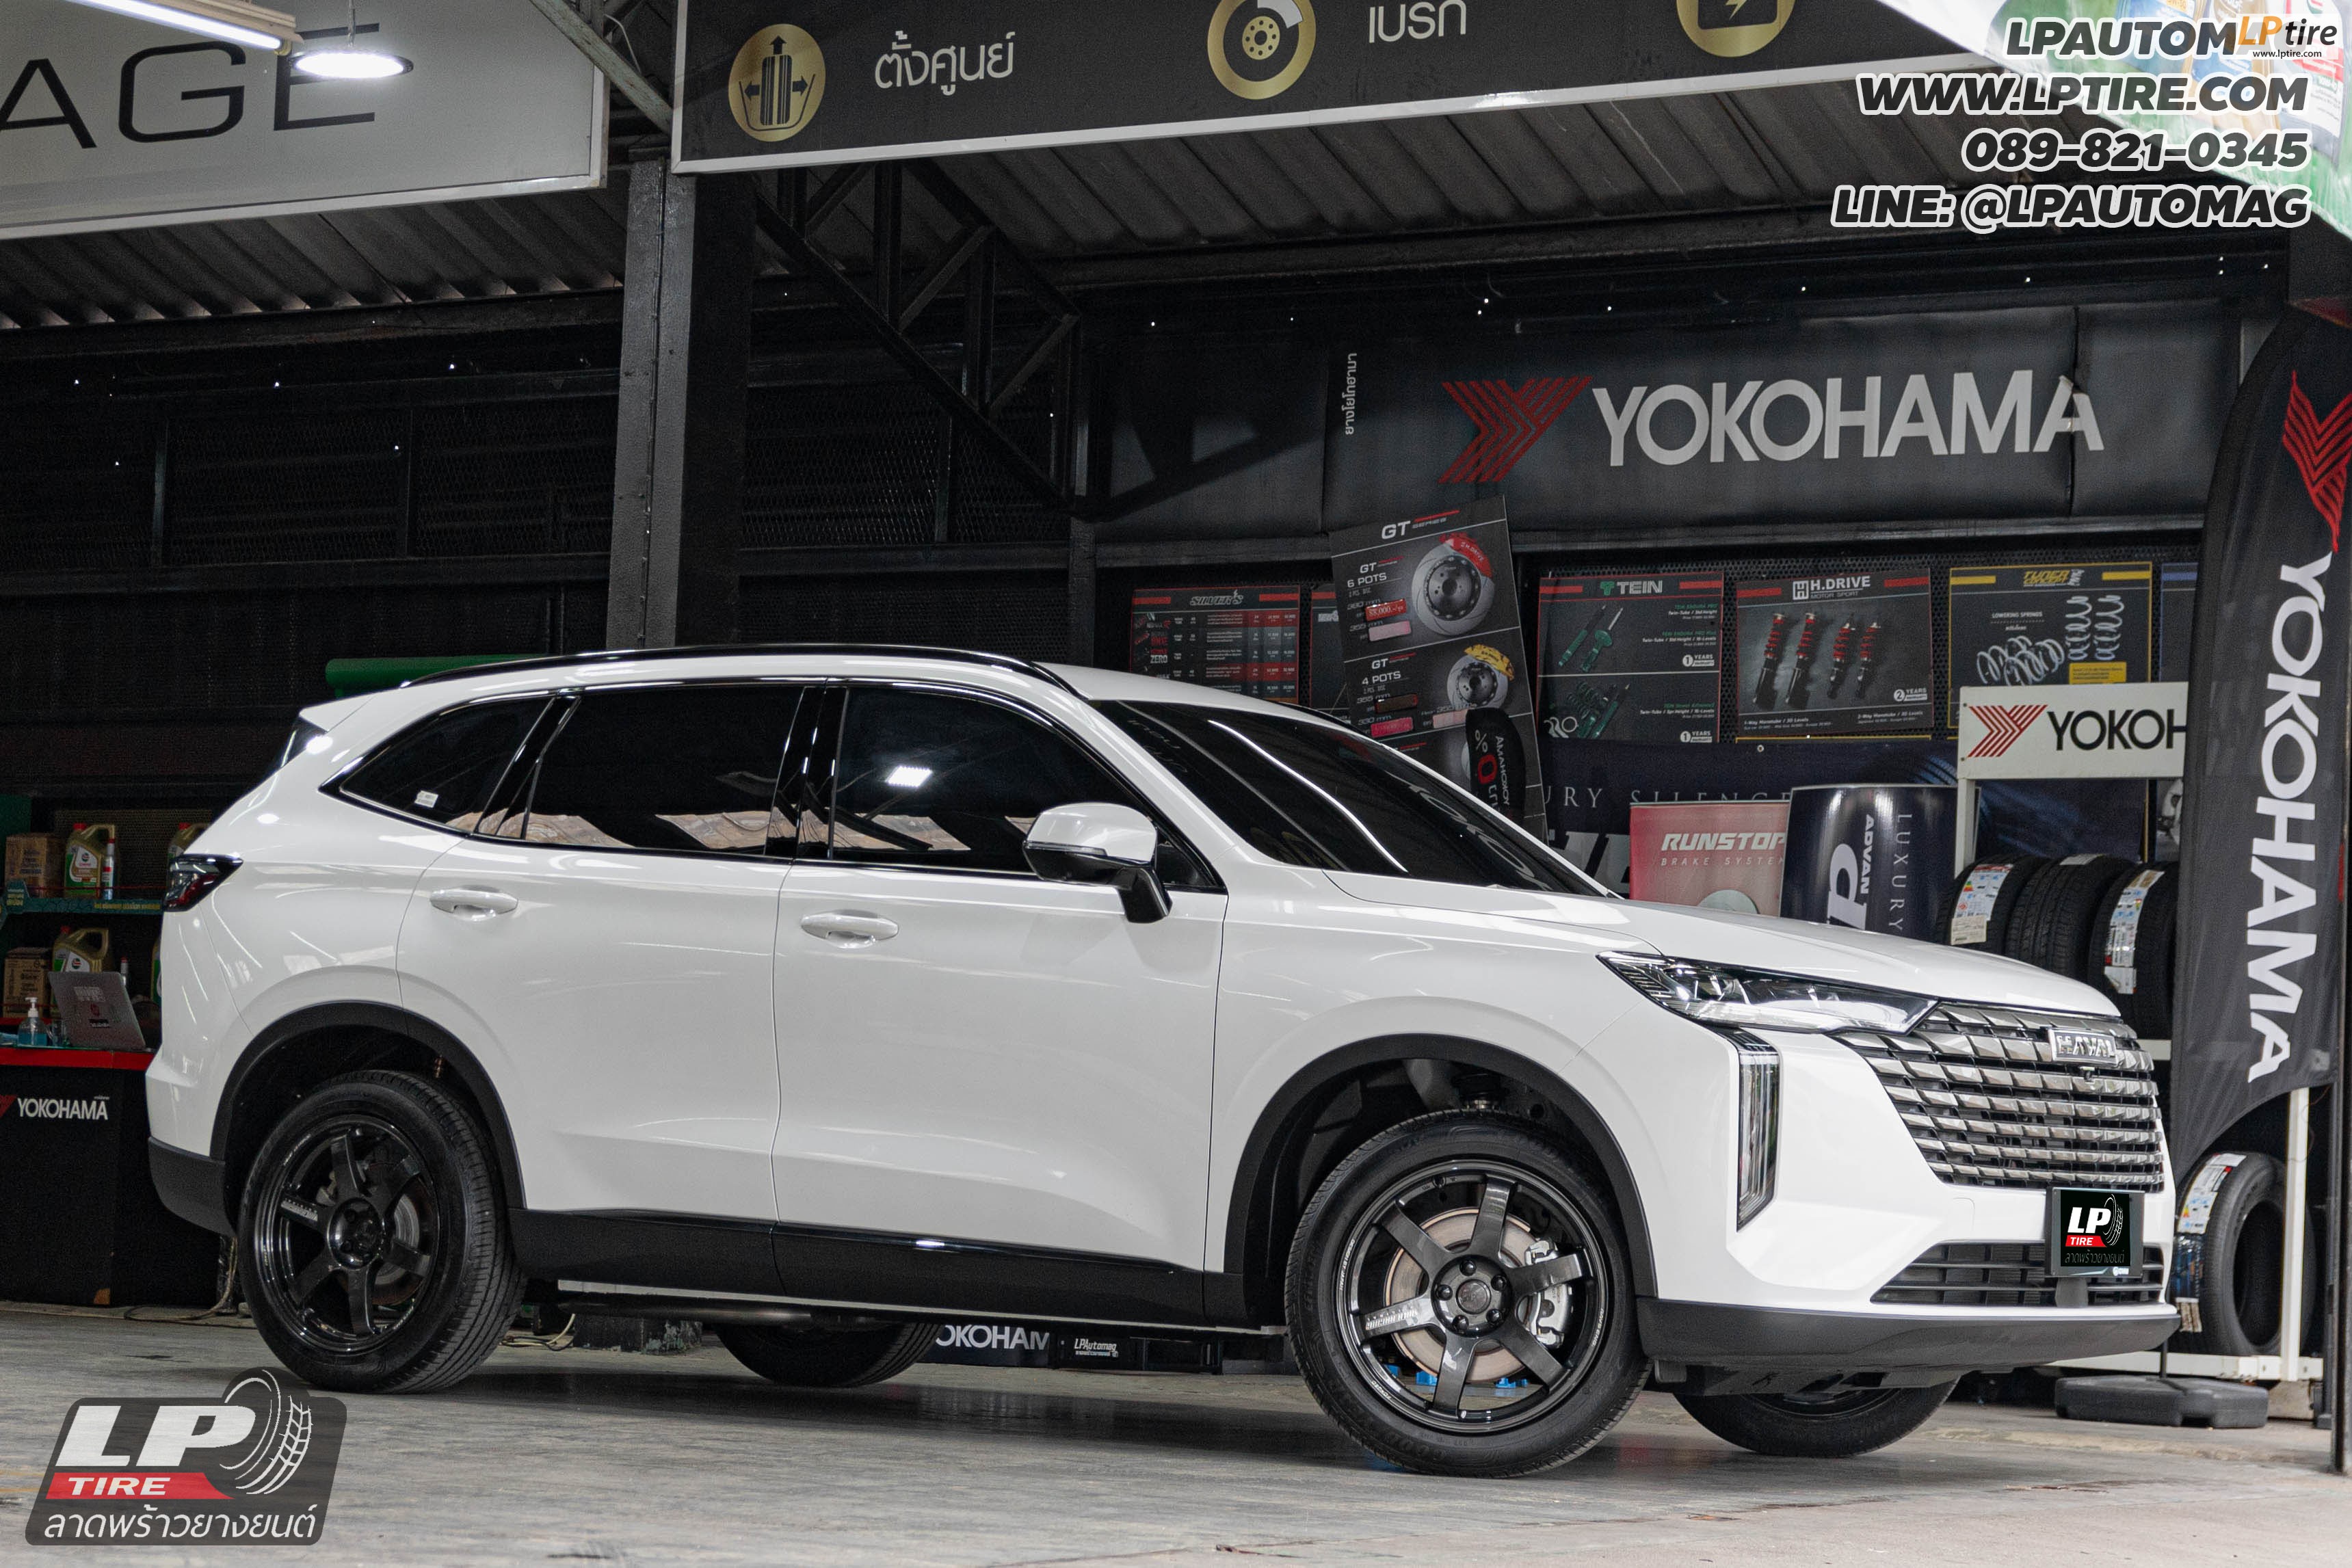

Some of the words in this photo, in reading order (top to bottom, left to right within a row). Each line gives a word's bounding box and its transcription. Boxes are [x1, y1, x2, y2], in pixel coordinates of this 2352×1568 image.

[875, 31, 1016, 95] ตั้งศูนย์
[1341, 352, 1358, 436] ยางโยโกฮามา
[1591, 369, 2104, 467] YOKOHAMA
[1382, 520, 1411, 540] GT
[1360, 562, 1377, 574] GT
[1347, 579, 1355, 588] 6
[1358, 572, 1387, 586] POTS
[1617, 580, 1663, 594] TEIN
[1810, 576, 1871, 590] H.DRIVE
[1150, 654, 1168, 663] ZERO
[1371, 658, 1389, 669] GT
[1362, 677, 1369, 685] 4
[1372, 671, 1401, 684] POTS
[2247, 550, 2333, 1083] YOKOHAMA
[1661, 857, 1710, 867] BRAKE
[1860, 814, 1875, 894] ADVAN
[1888, 814, 1912, 931] LUXURY
[17, 1098, 109, 1120] YOKOHAMA
[1074, 1338, 1117, 1352] LPAutomag
